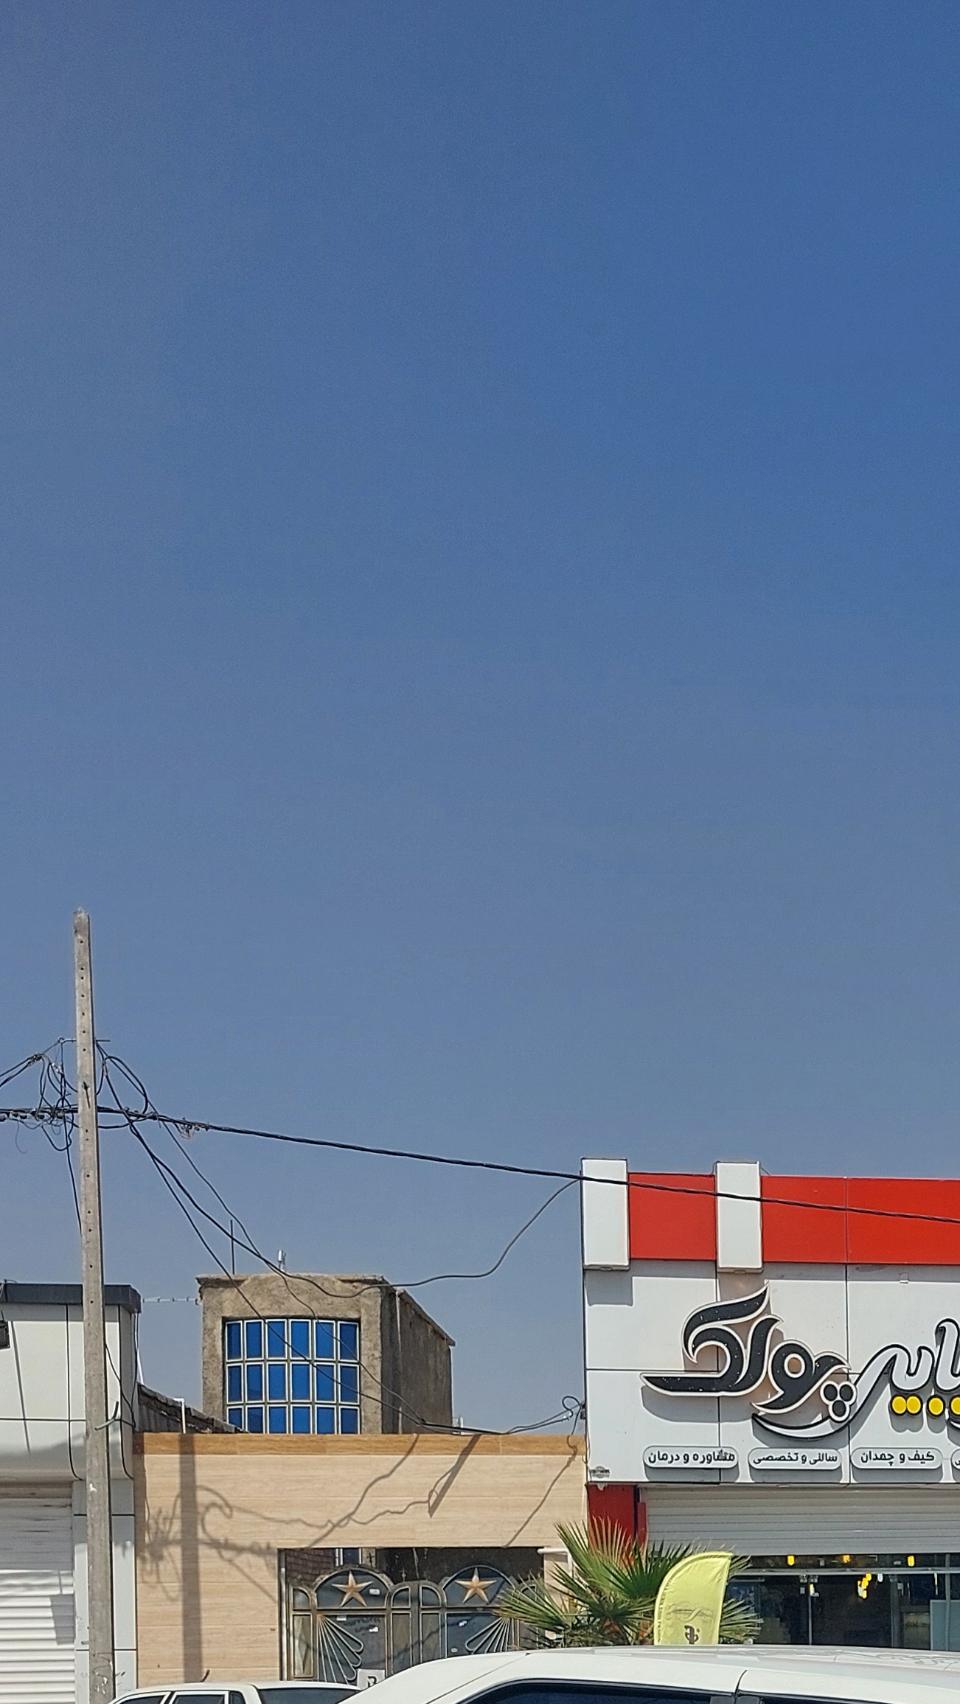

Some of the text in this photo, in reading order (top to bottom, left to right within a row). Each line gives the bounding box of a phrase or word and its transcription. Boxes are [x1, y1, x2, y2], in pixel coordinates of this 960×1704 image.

[648, 1450, 680, 1464] درمان
[683, 1454, 690, 1464] و
[752, 1452, 799, 1466] تخصصی
[801, 1455, 808, 1465] و
[860, 1450, 935, 1467] کیف و چمدان
